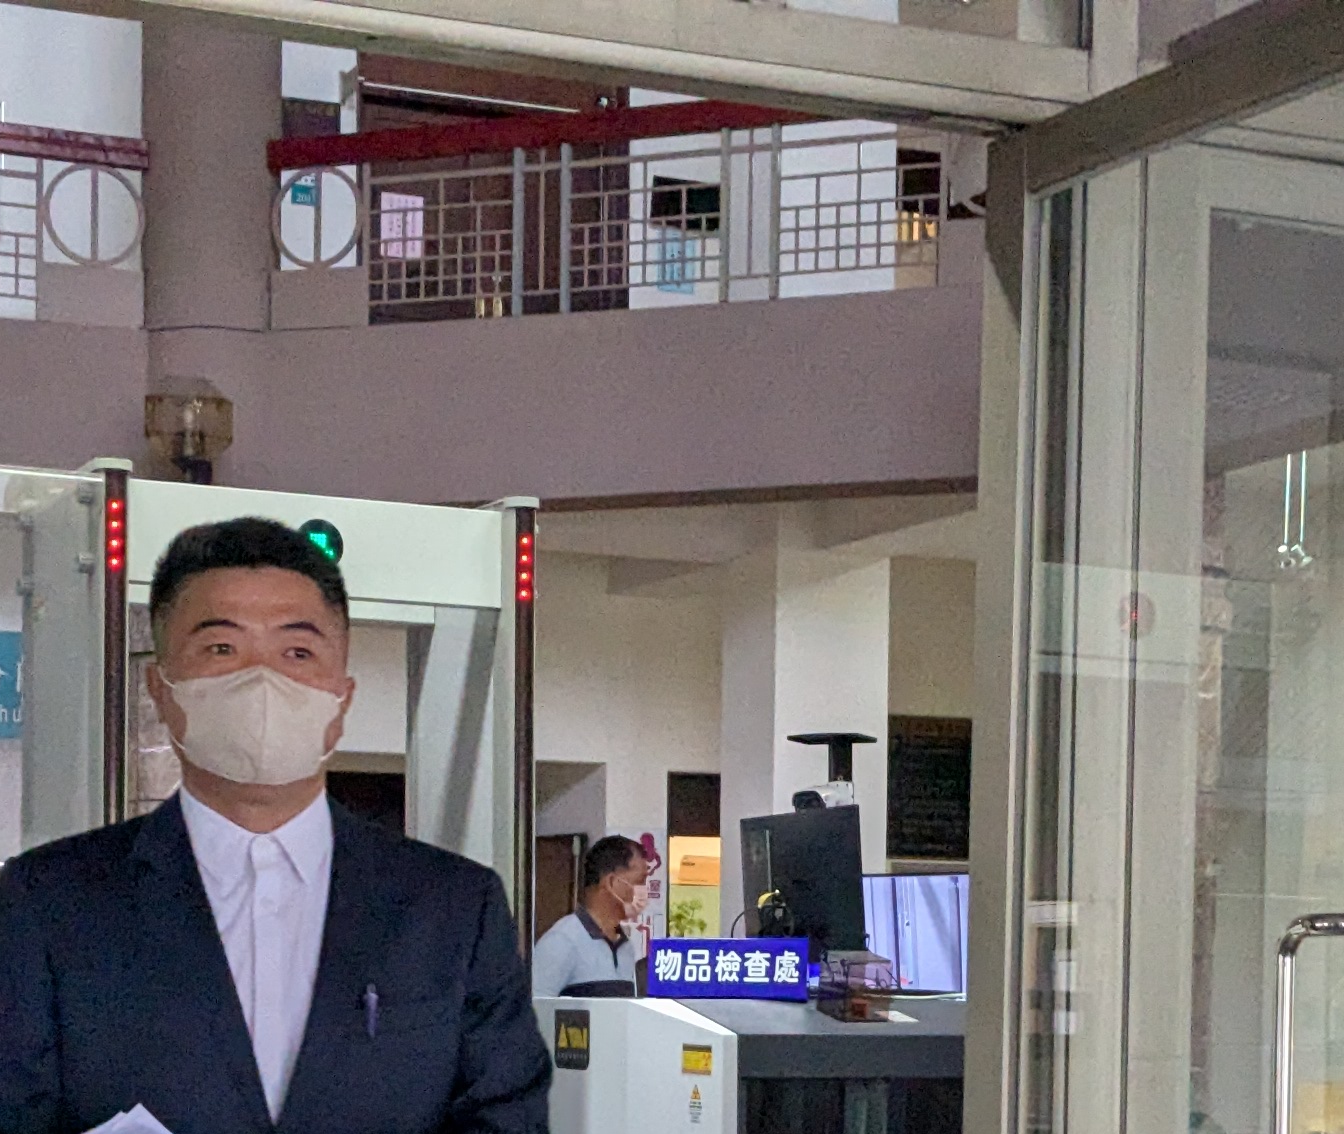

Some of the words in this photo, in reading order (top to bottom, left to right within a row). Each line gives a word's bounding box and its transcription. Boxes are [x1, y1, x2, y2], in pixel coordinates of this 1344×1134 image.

[654, 948, 801, 984] 物品檢查處
